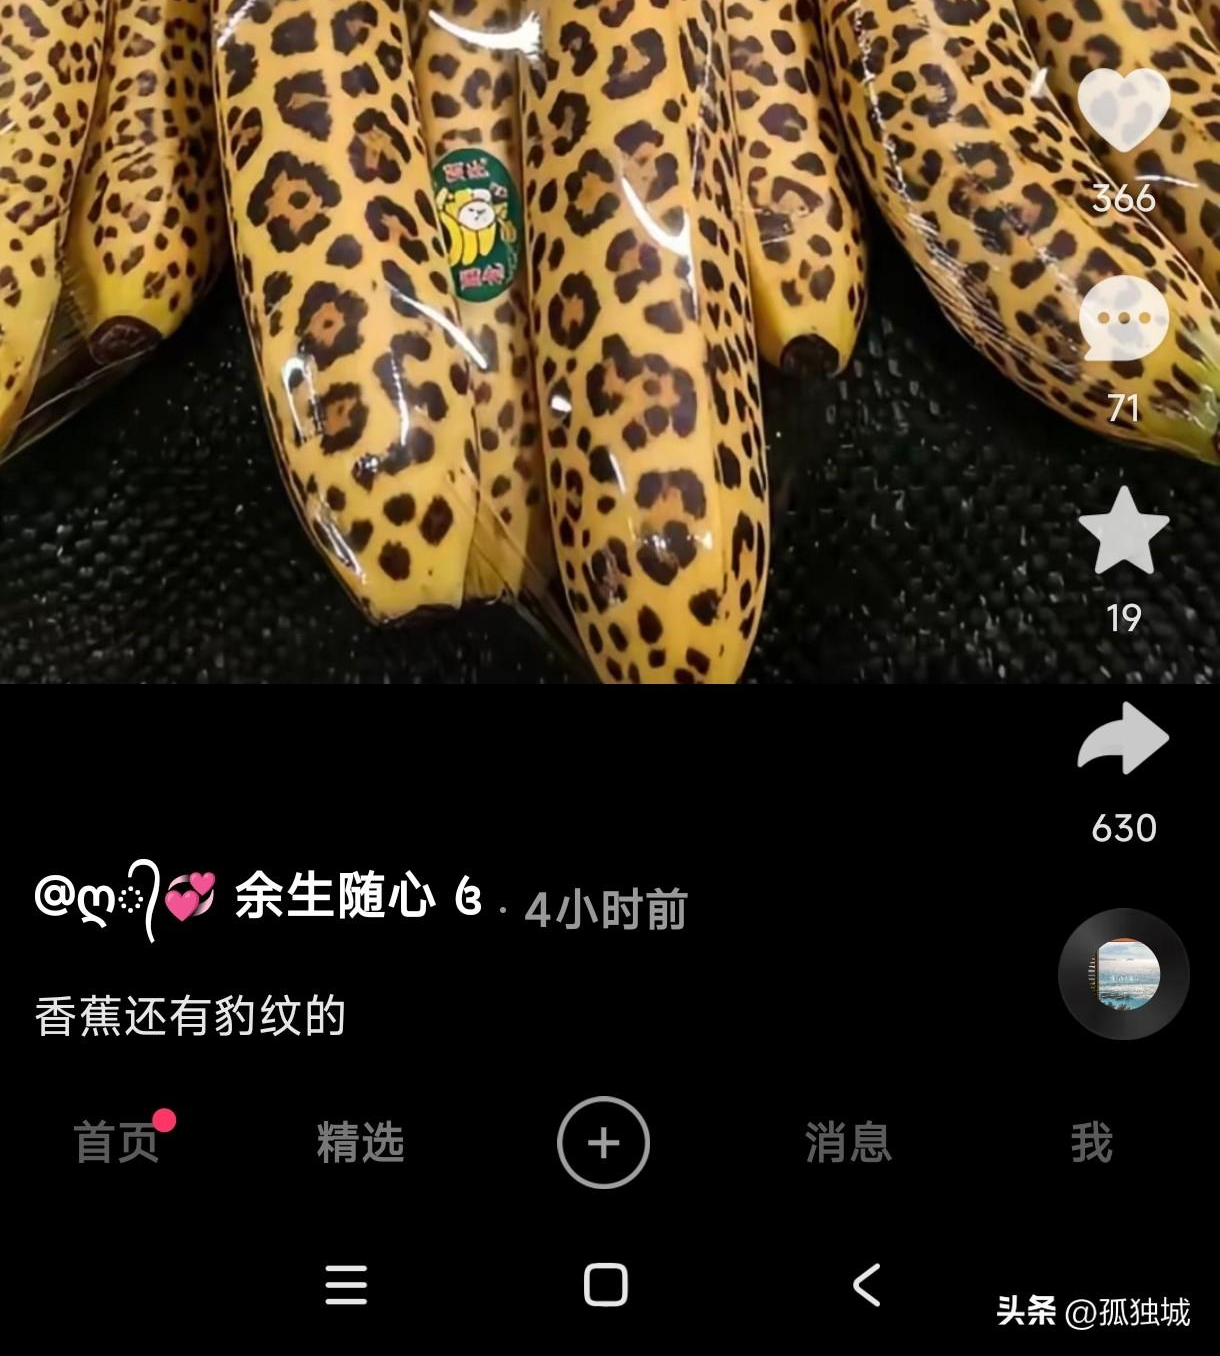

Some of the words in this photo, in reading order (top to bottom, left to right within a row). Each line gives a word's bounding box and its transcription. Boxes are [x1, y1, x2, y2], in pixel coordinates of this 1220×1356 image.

[1092, 184, 1156, 212] 366
[1107, 394, 1140, 422] 71
[1107, 603, 1143, 632] 19
[1092, 813, 1157, 843] 630
[235, 869, 437, 920] 余生随心
[524, 886, 689, 931] 4小时前
[35, 993, 345, 1038] 香蕉还有豹纹的
[73, 1119, 160, 1164] 首页
[316, 1119, 405, 1164] 精选
[805, 1120, 893, 1164] 消息
[1071, 1120, 1114, 1164] 我
